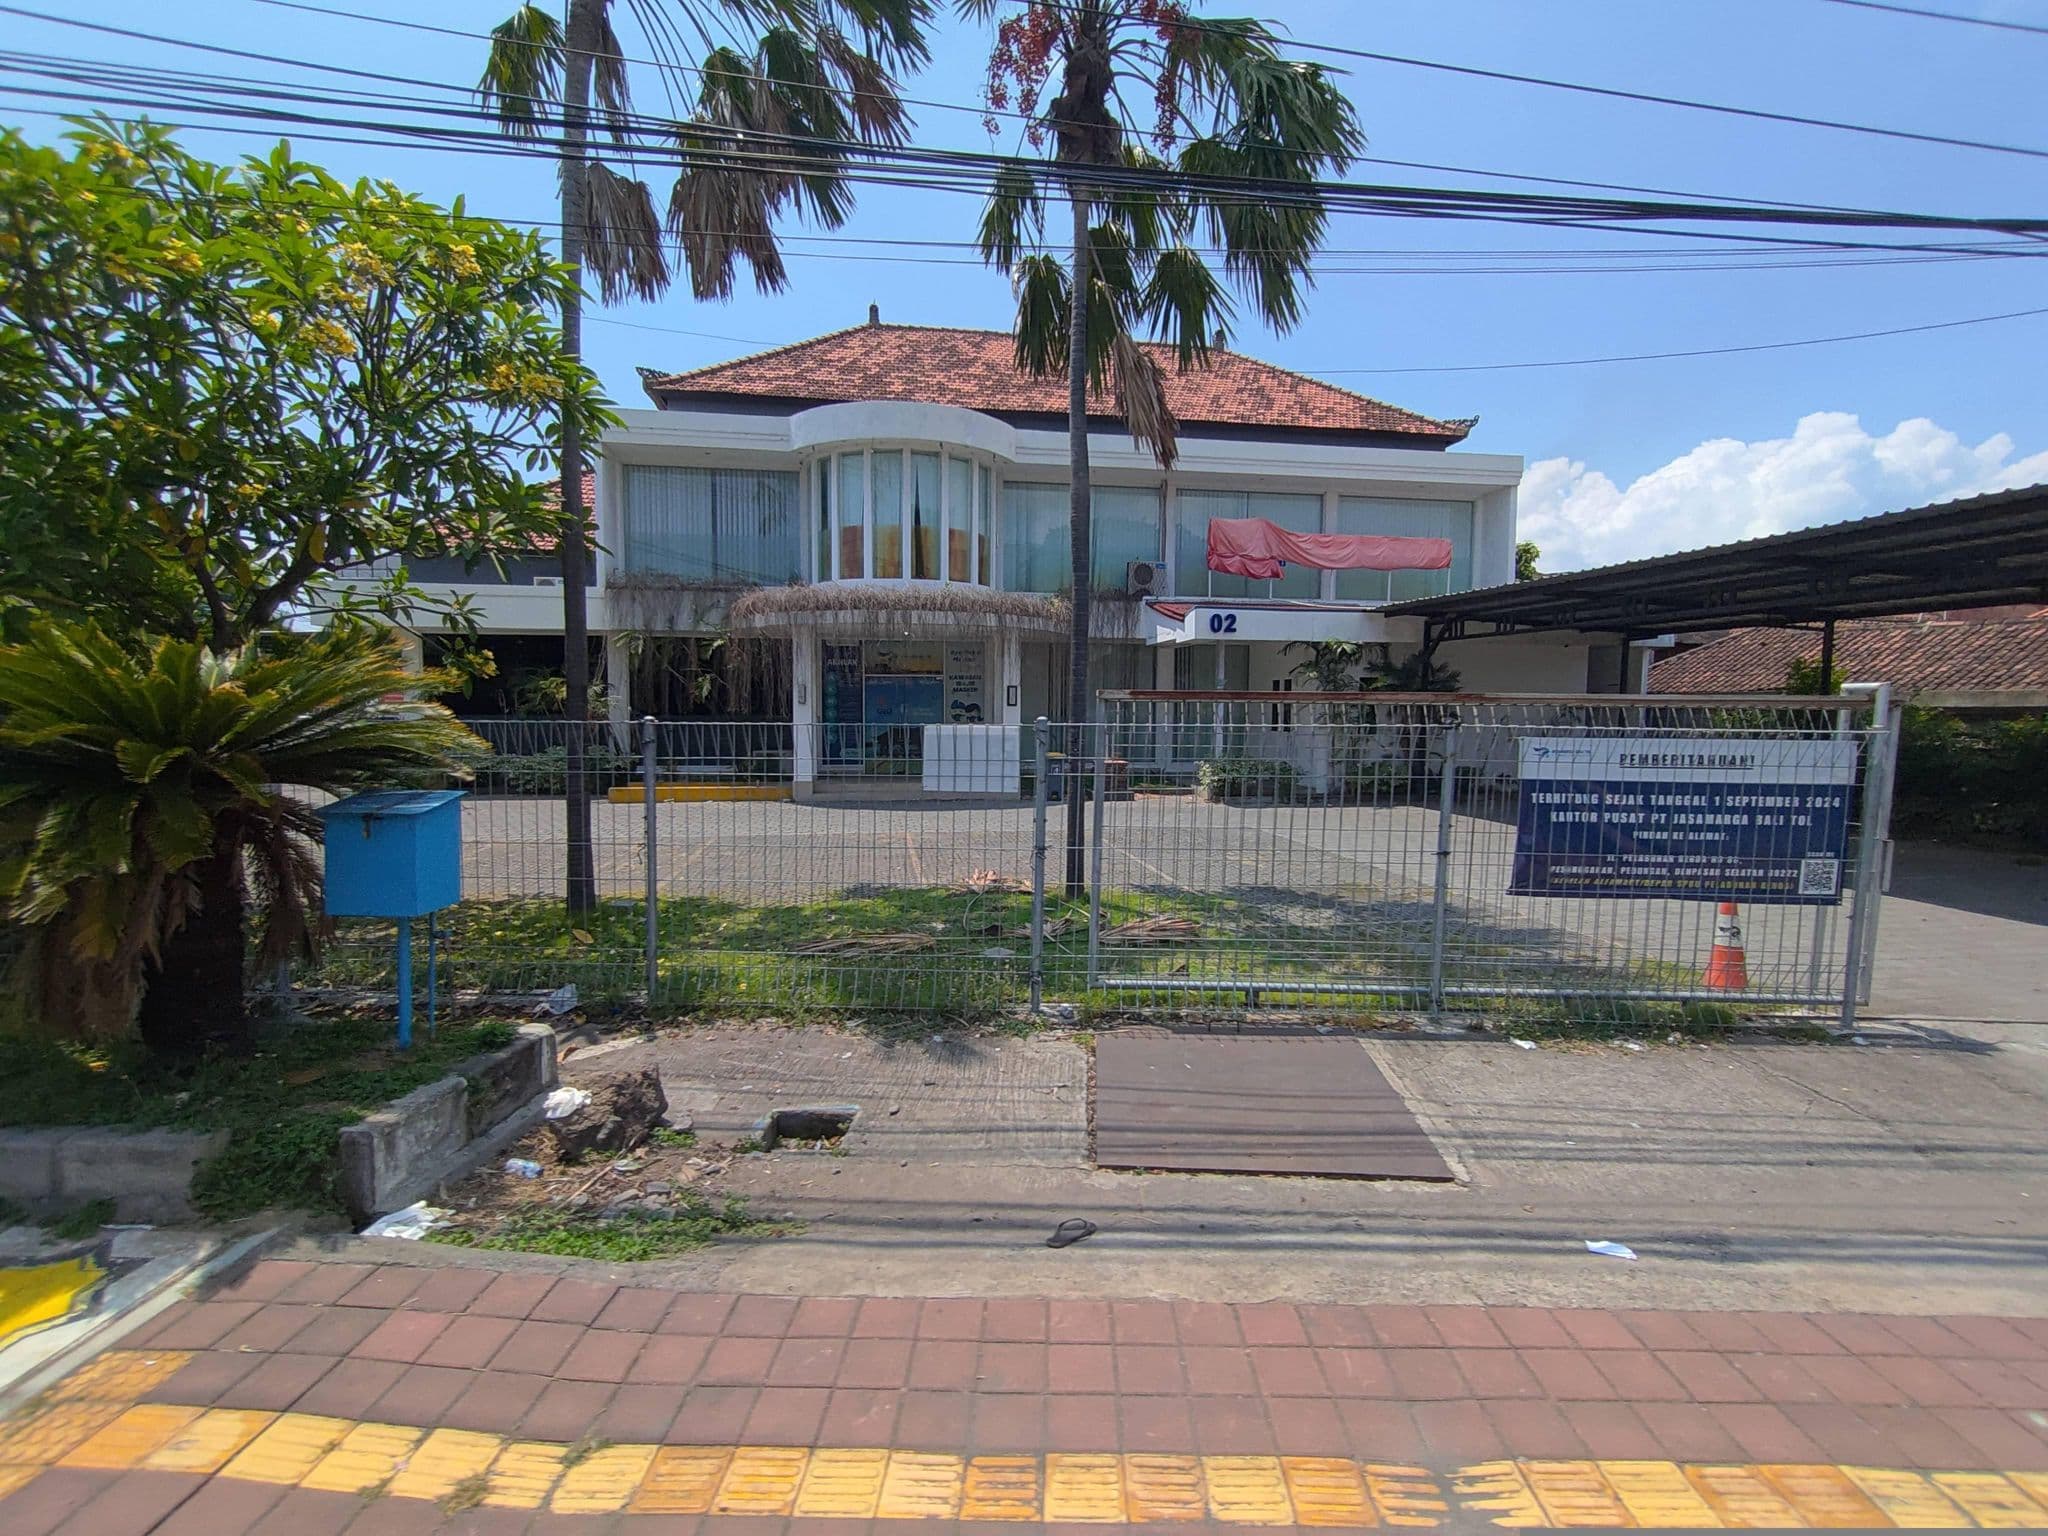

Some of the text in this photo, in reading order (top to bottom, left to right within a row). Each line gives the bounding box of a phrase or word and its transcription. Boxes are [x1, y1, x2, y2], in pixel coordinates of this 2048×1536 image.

[1209, 613, 1237, 633] 02
[1619, 753, 1755, 767] PEMBERITAHUAN!
[1531, 793, 1841, 808] TERHITUNG SEJAK TANGGAL 1 SEPTEMBER 2024
[1551, 811, 1813, 826] KANTOR PUSAT PT JASAMARGA BALI TOL
[1672, 831, 1685, 840] KE
[1724, 869, 1764, 877] SELATAN
